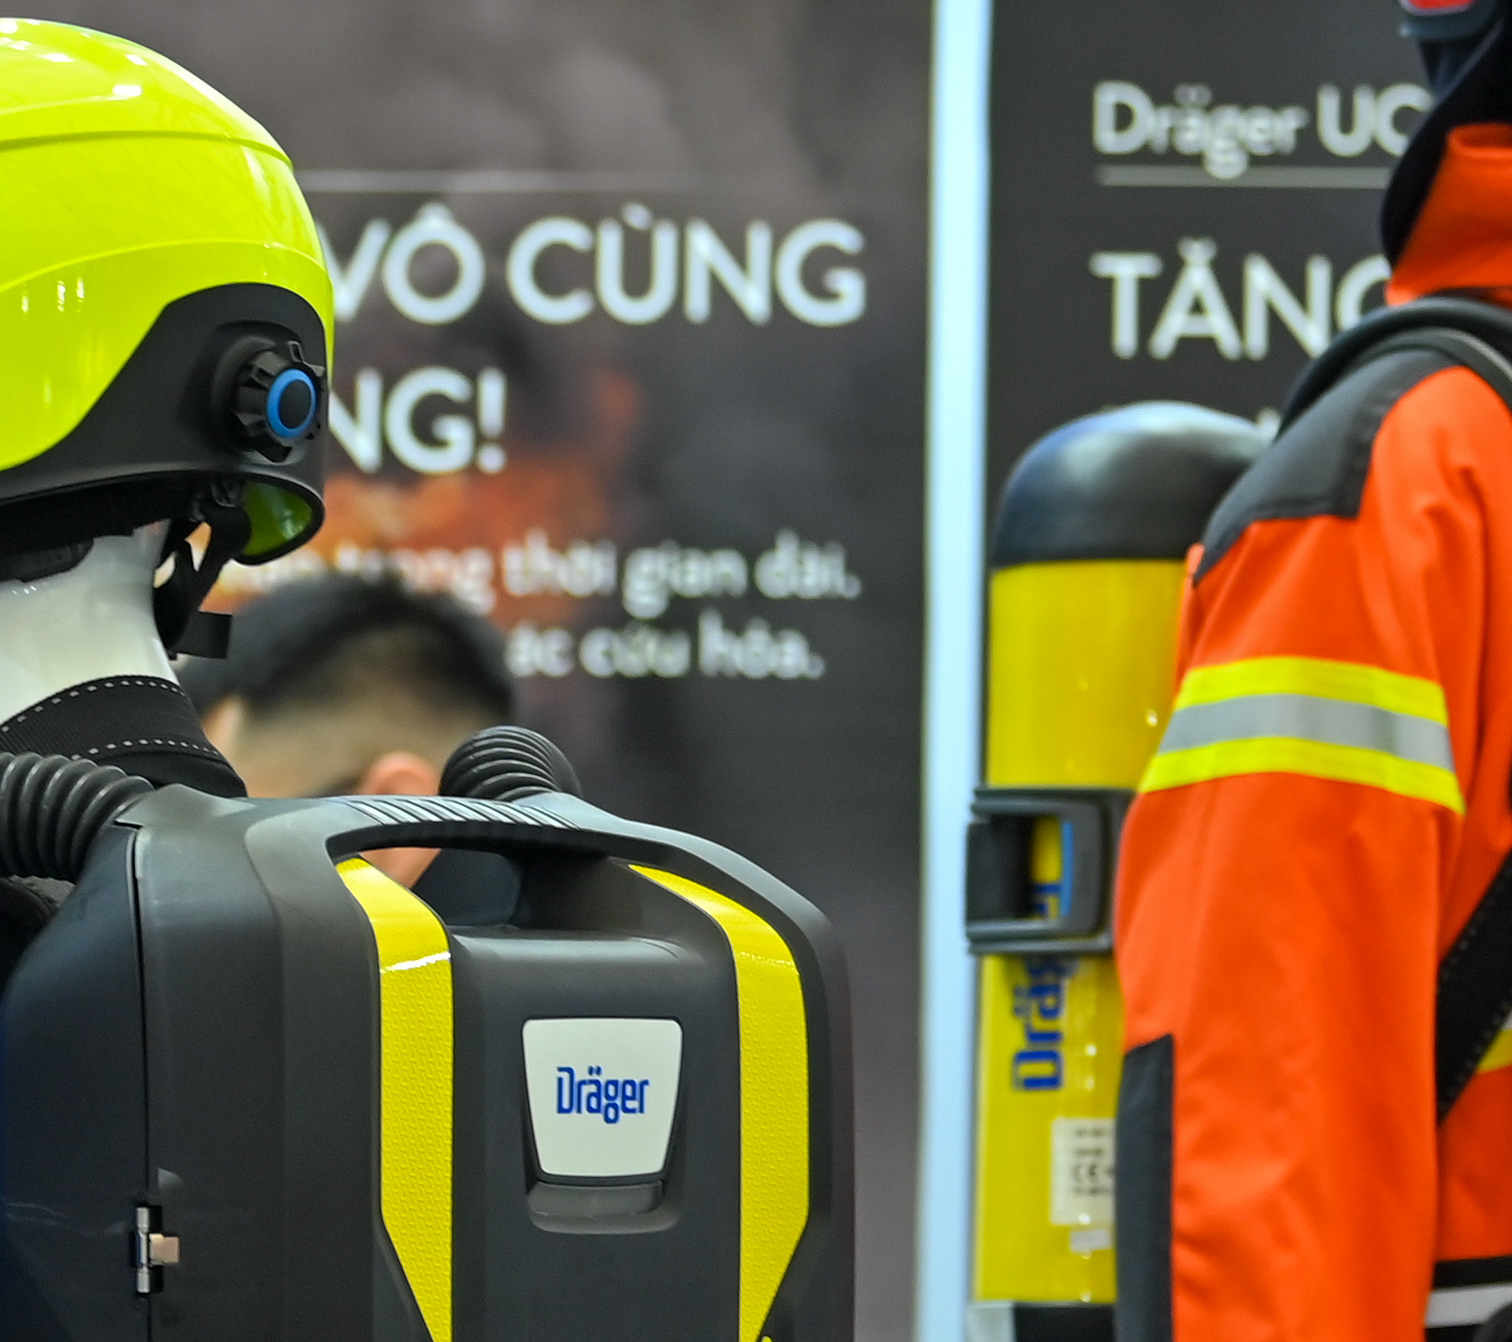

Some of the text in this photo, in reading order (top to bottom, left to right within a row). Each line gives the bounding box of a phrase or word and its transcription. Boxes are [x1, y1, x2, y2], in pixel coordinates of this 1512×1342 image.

[1092, 80, 1434, 180] Dräger UC
[317, 202, 866, 327] VÔ CÙNG
[328, 365, 507, 475] NG!
[623, 539, 749, 620] gian
[556, 1065, 651, 1125] Dräger
